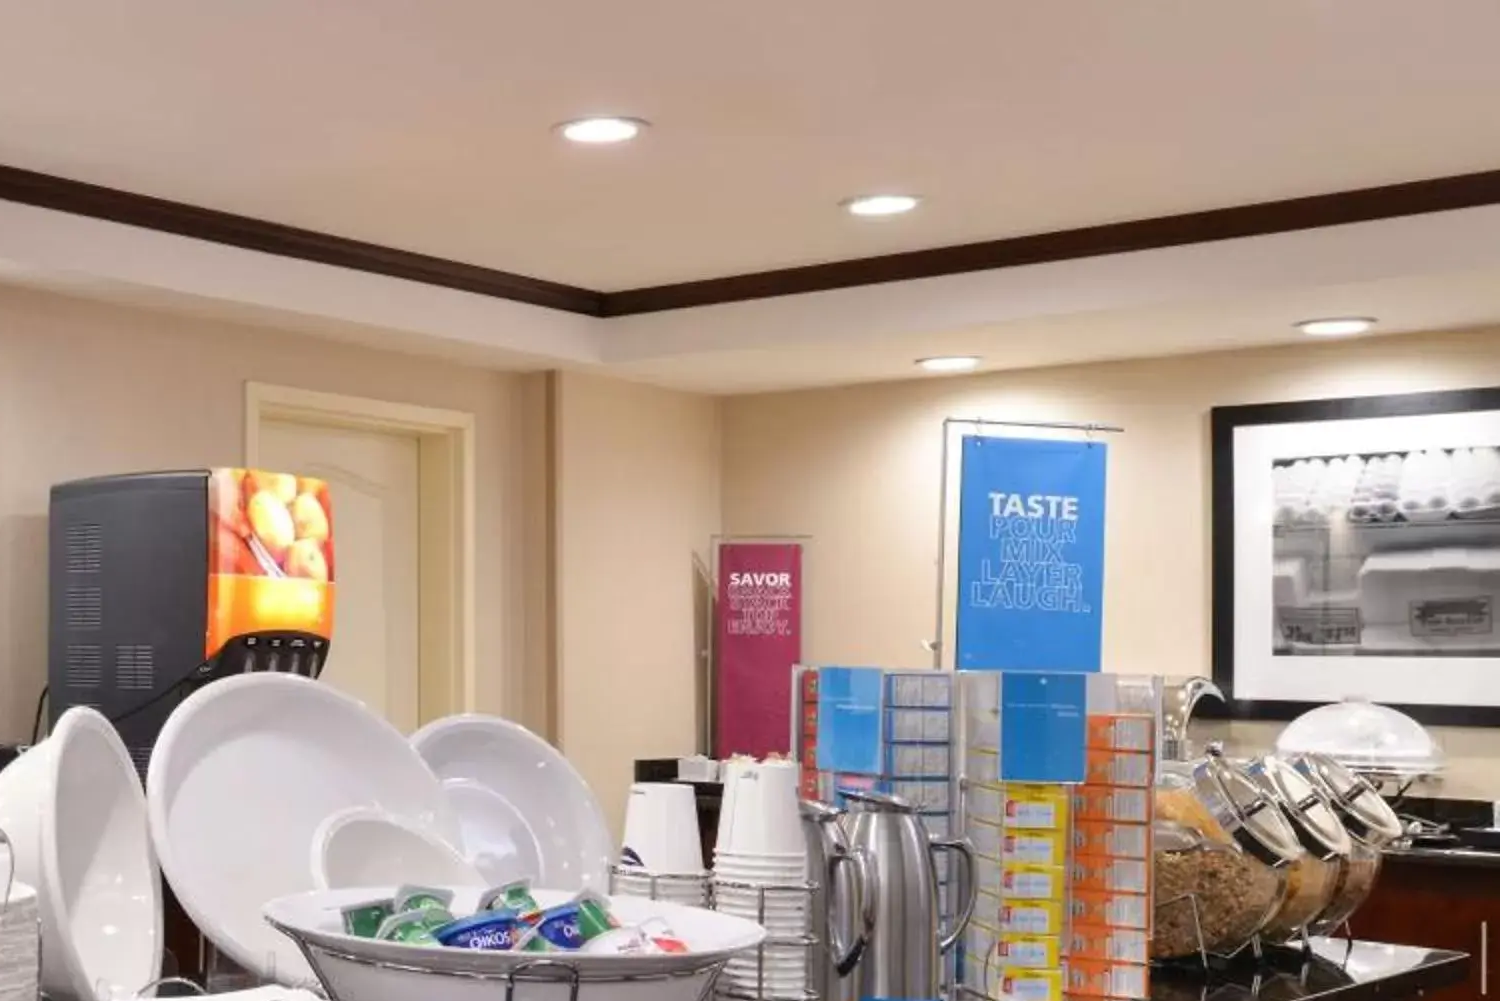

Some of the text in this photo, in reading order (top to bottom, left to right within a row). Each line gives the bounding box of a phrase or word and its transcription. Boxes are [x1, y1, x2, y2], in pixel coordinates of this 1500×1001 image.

[988, 492, 1079, 521] TASTE
[989, 516, 1076, 544] POUR
[1001, 537, 1065, 565] MIX
[729, 572, 792, 588] SAVOR
[980, 559, 1083, 596] LAYER
[970, 581, 1092, 614] LAUGH.
